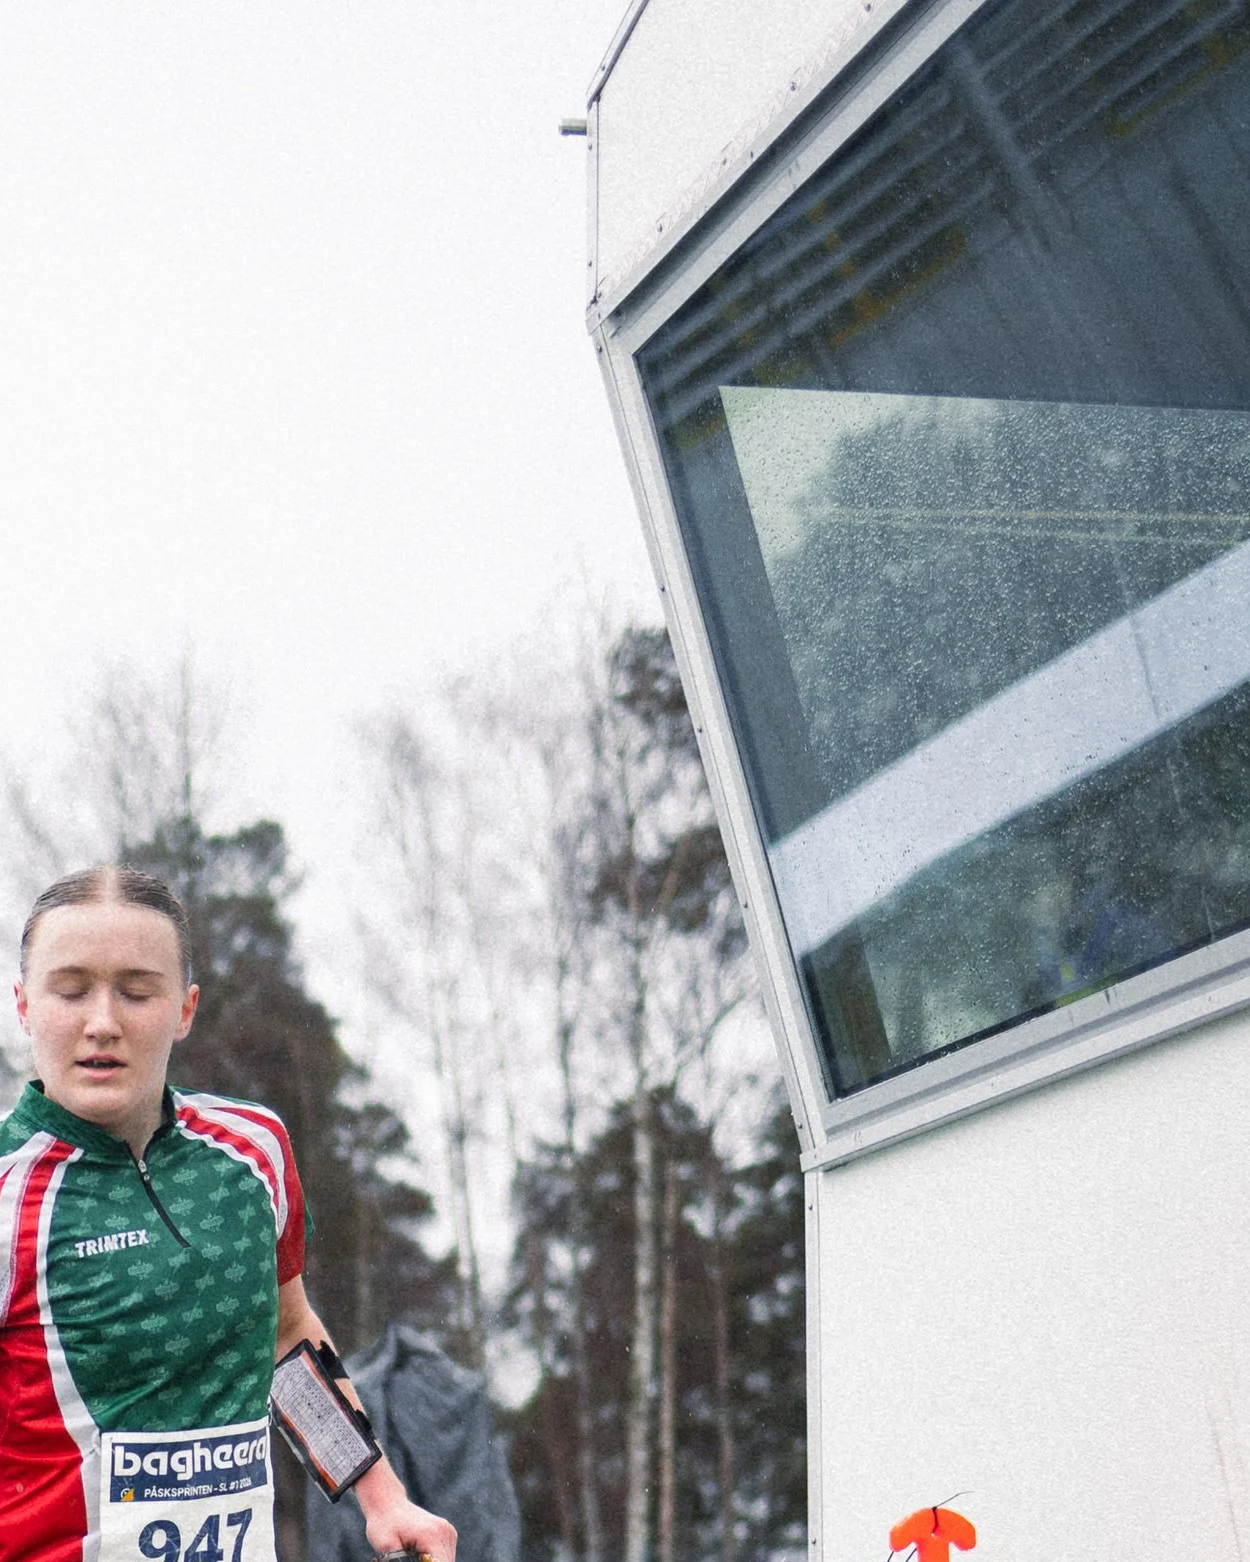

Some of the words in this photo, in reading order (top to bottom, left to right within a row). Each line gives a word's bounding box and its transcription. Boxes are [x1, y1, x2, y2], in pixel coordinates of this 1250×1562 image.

[74, 1229, 149, 1258] TRIMTEX
[113, 1435, 267, 1481] bagheera
[143, 1484, 213, 1498] PÅSKSPRINTEN
[219, 1482, 228, 1493] SL
